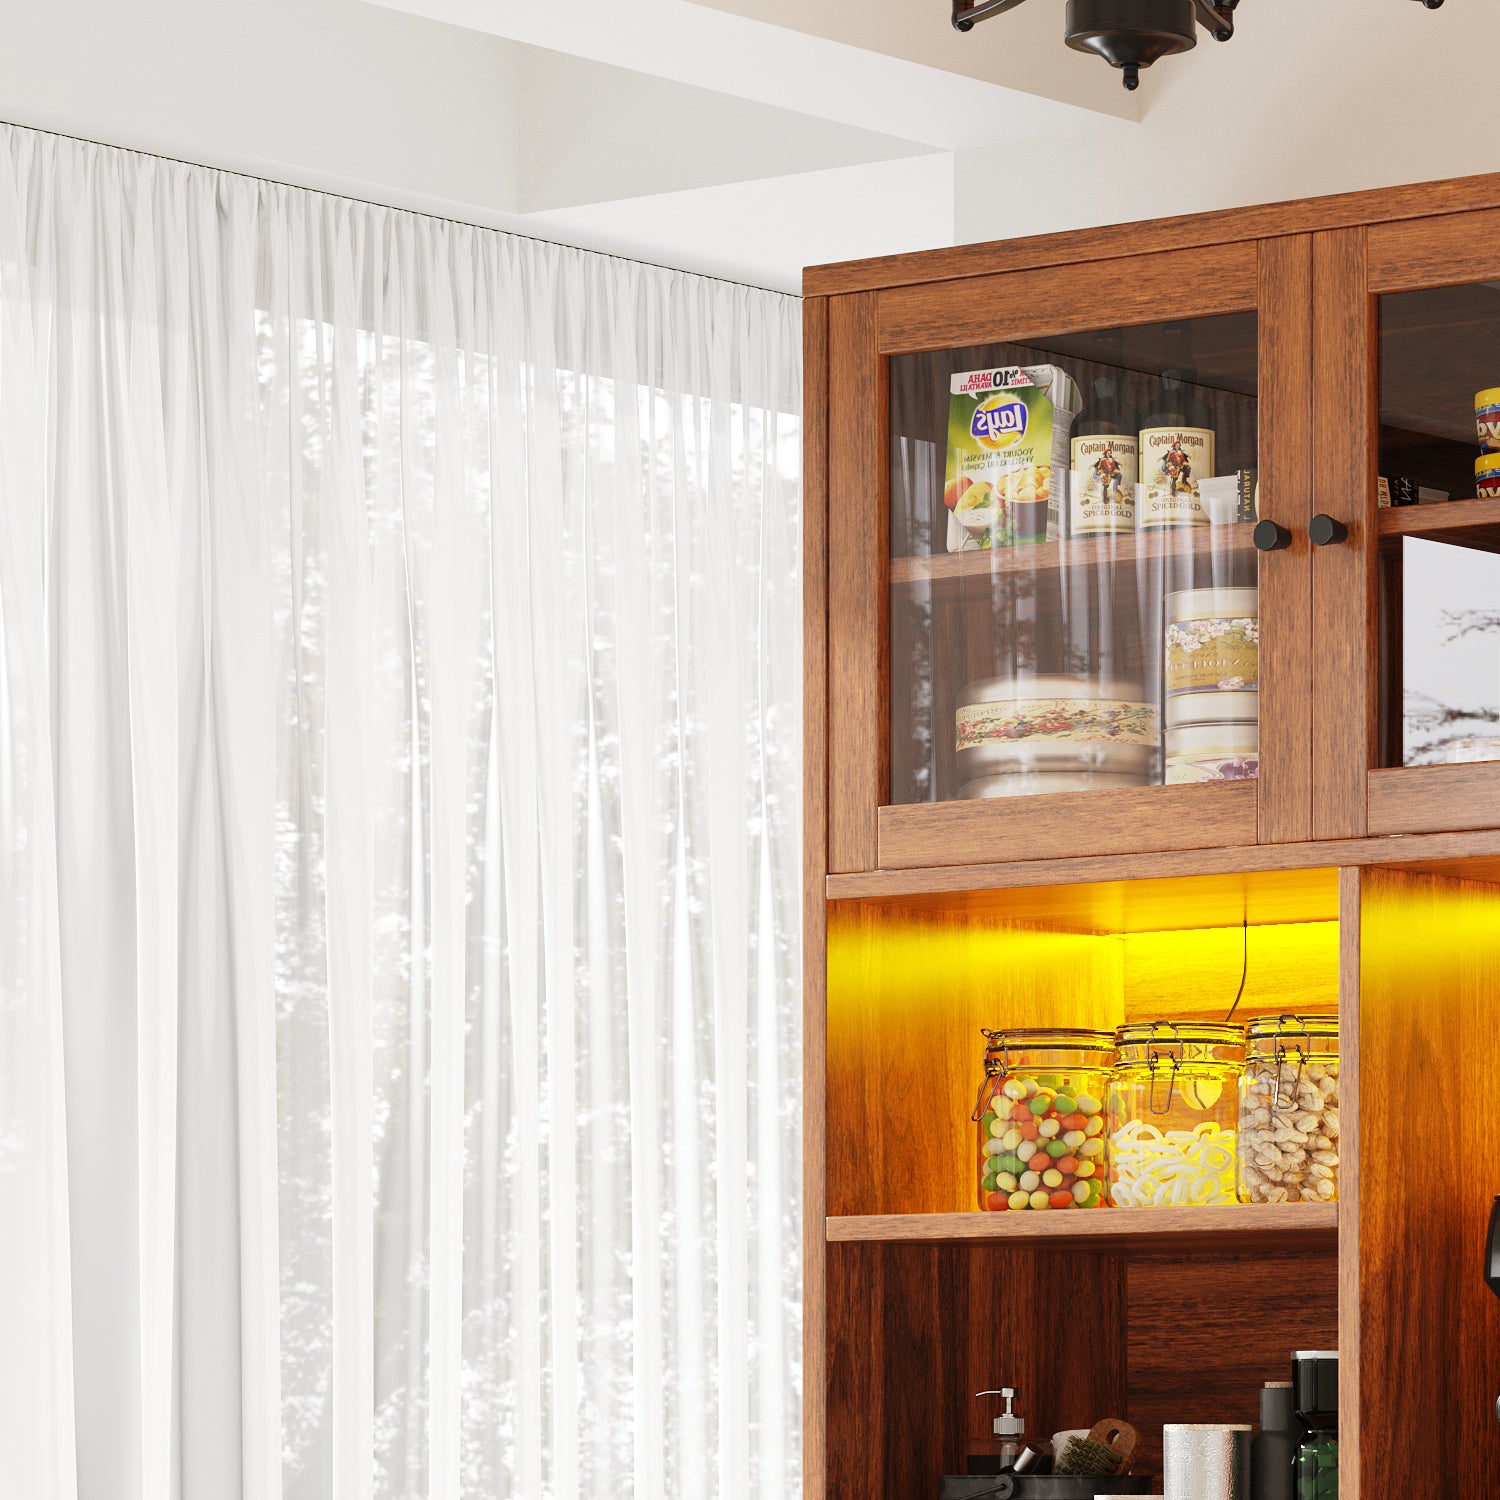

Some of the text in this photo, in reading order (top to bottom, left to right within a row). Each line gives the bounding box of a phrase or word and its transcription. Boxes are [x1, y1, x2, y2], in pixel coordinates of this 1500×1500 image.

[1149, 432, 1204, 447] Captain Morgan
[1080, 441, 1135, 455] Captain Morgan
[1151, 502, 1201, 512] SPICED GOLD
[1083, 509, 1132, 519] SPICED GOLD
